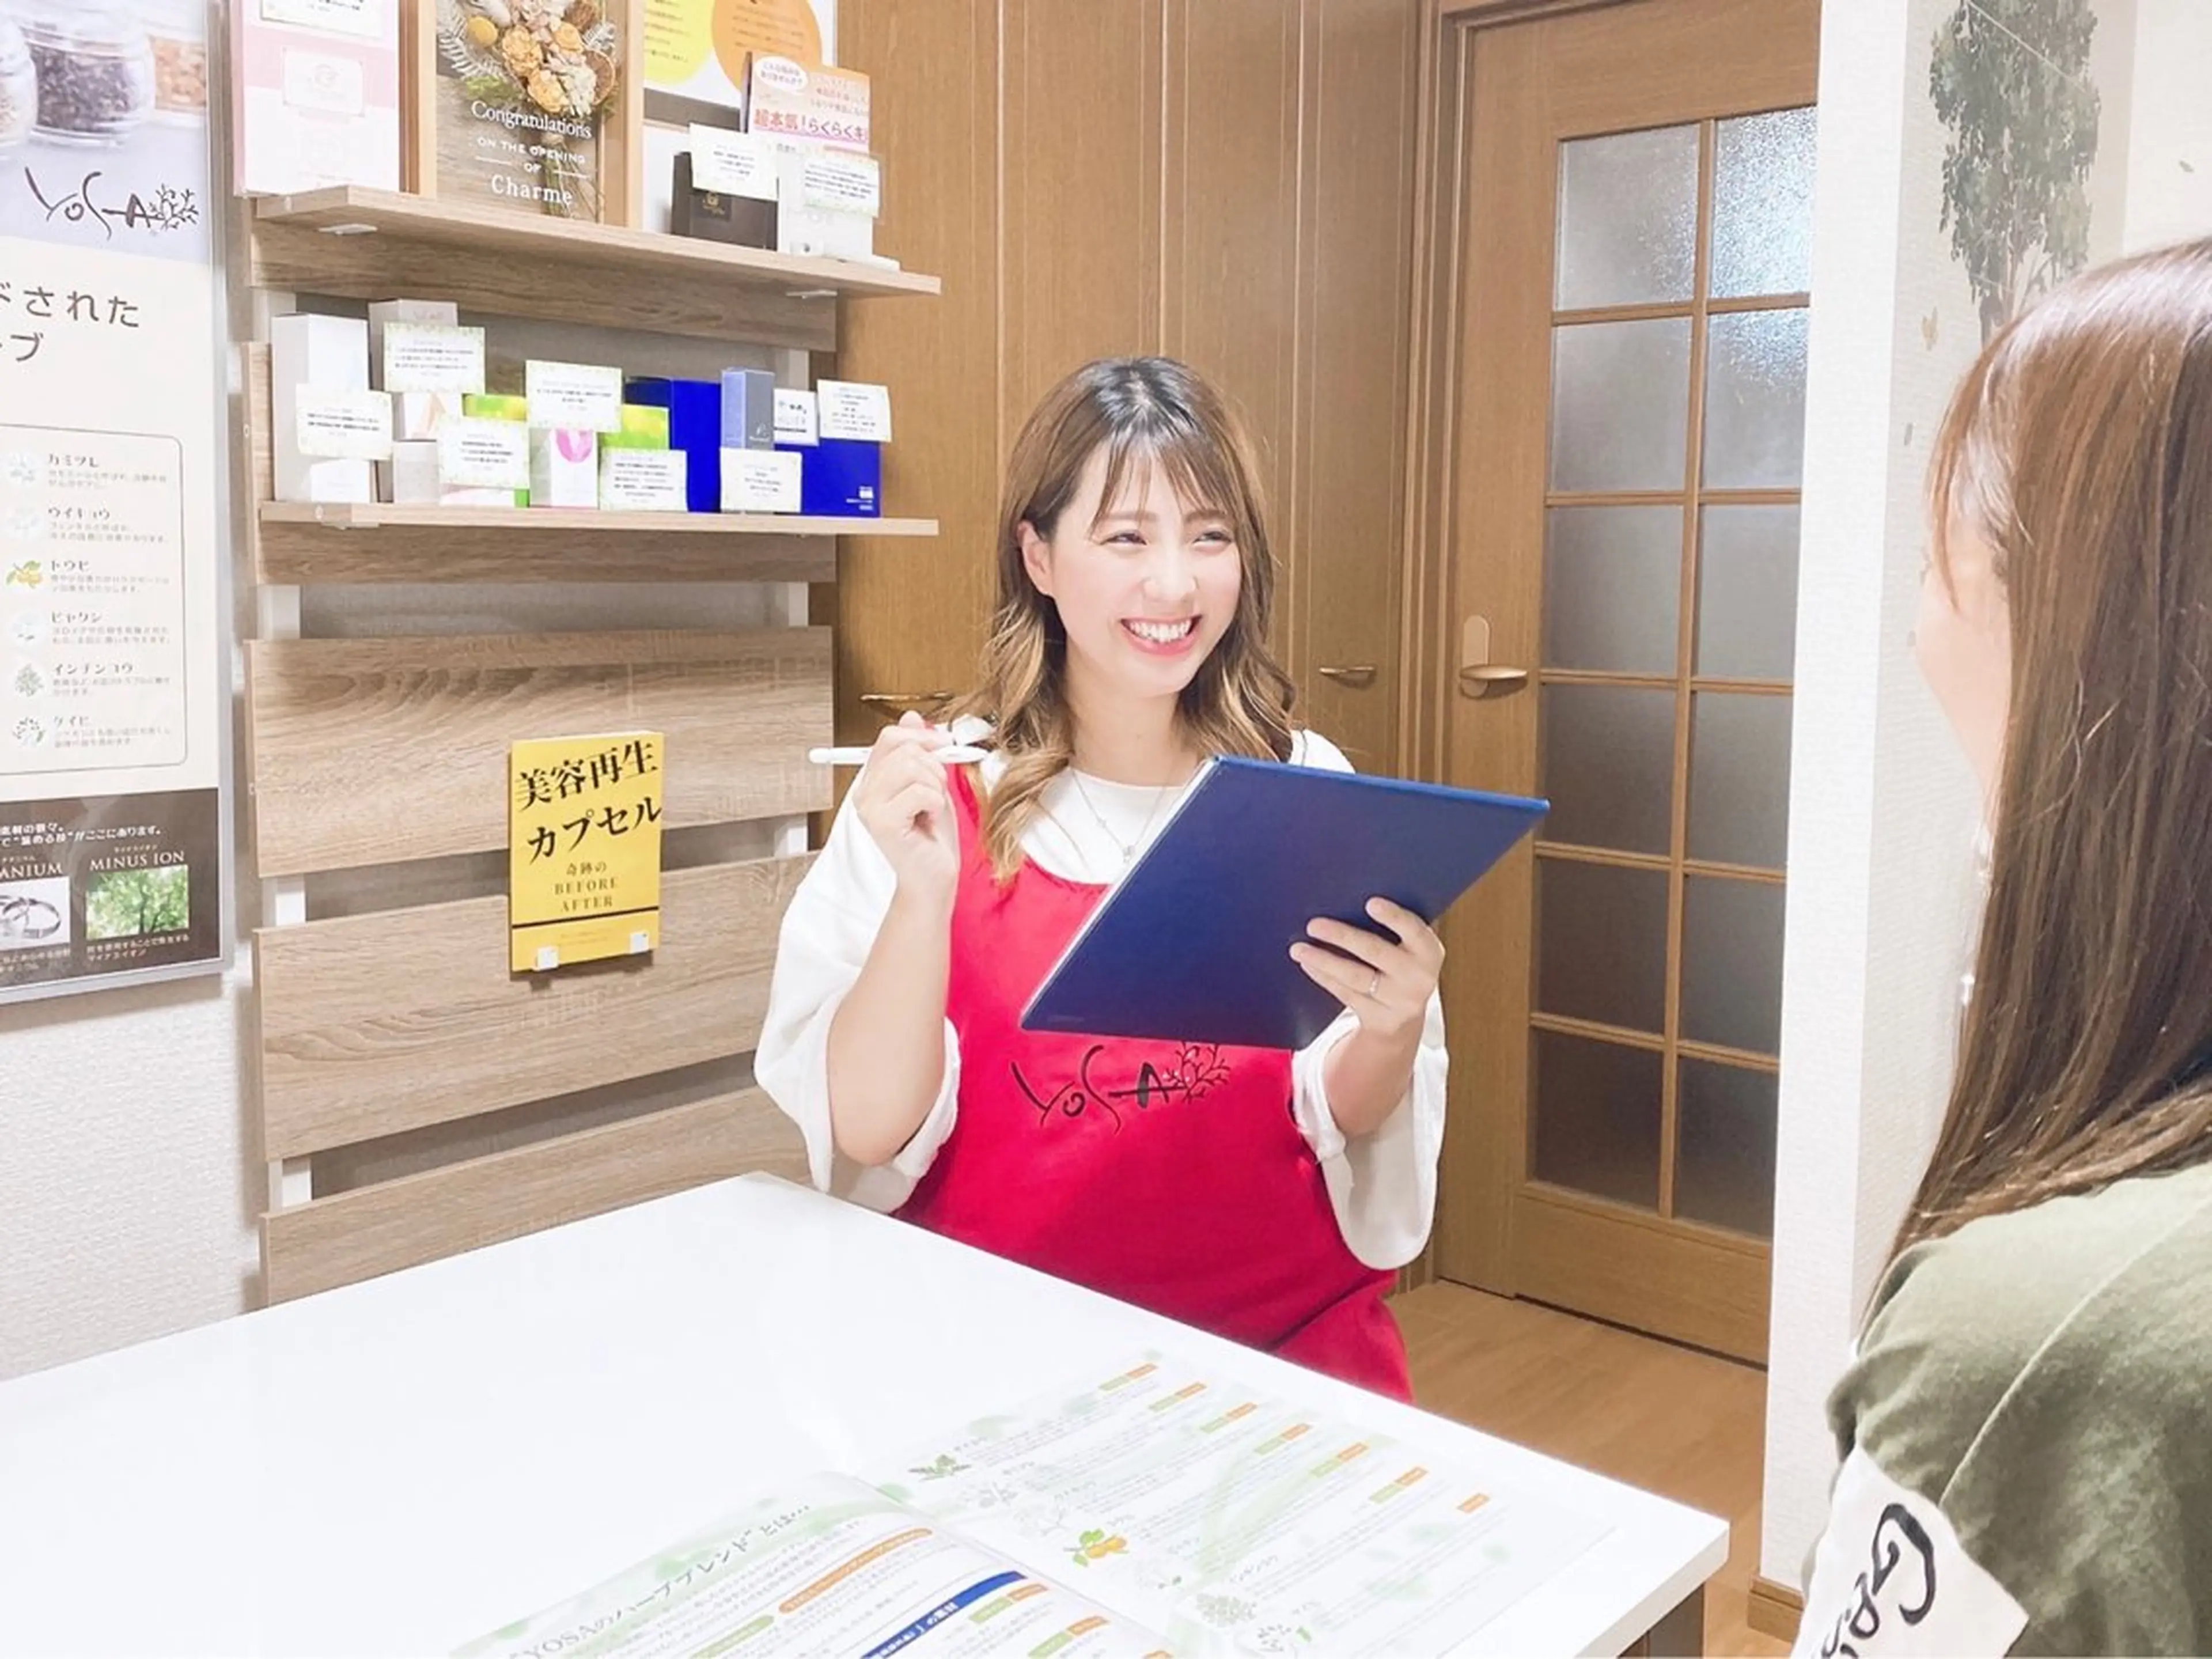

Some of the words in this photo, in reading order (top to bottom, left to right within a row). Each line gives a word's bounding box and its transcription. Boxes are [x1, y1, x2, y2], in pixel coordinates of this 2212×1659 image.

[471, 100, 592, 139] Congratulations
[477, 137, 497, 147] ON
[501, 140, 526, 154] THE
[529, 146, 585, 164] OPENING
[524, 162, 542, 173] OF
[491, 174, 573, 203] Charme
[515, 740, 658, 812] 美容再生
[527, 797, 662, 865] カプセル
[89, 854, 148, 872] MINUS
[153, 850, 185, 866] ION
[566, 861, 607, 877] 奇跡の
[554, 877, 617, 895] BEFORE
[560, 896, 613, 912] AFTER
